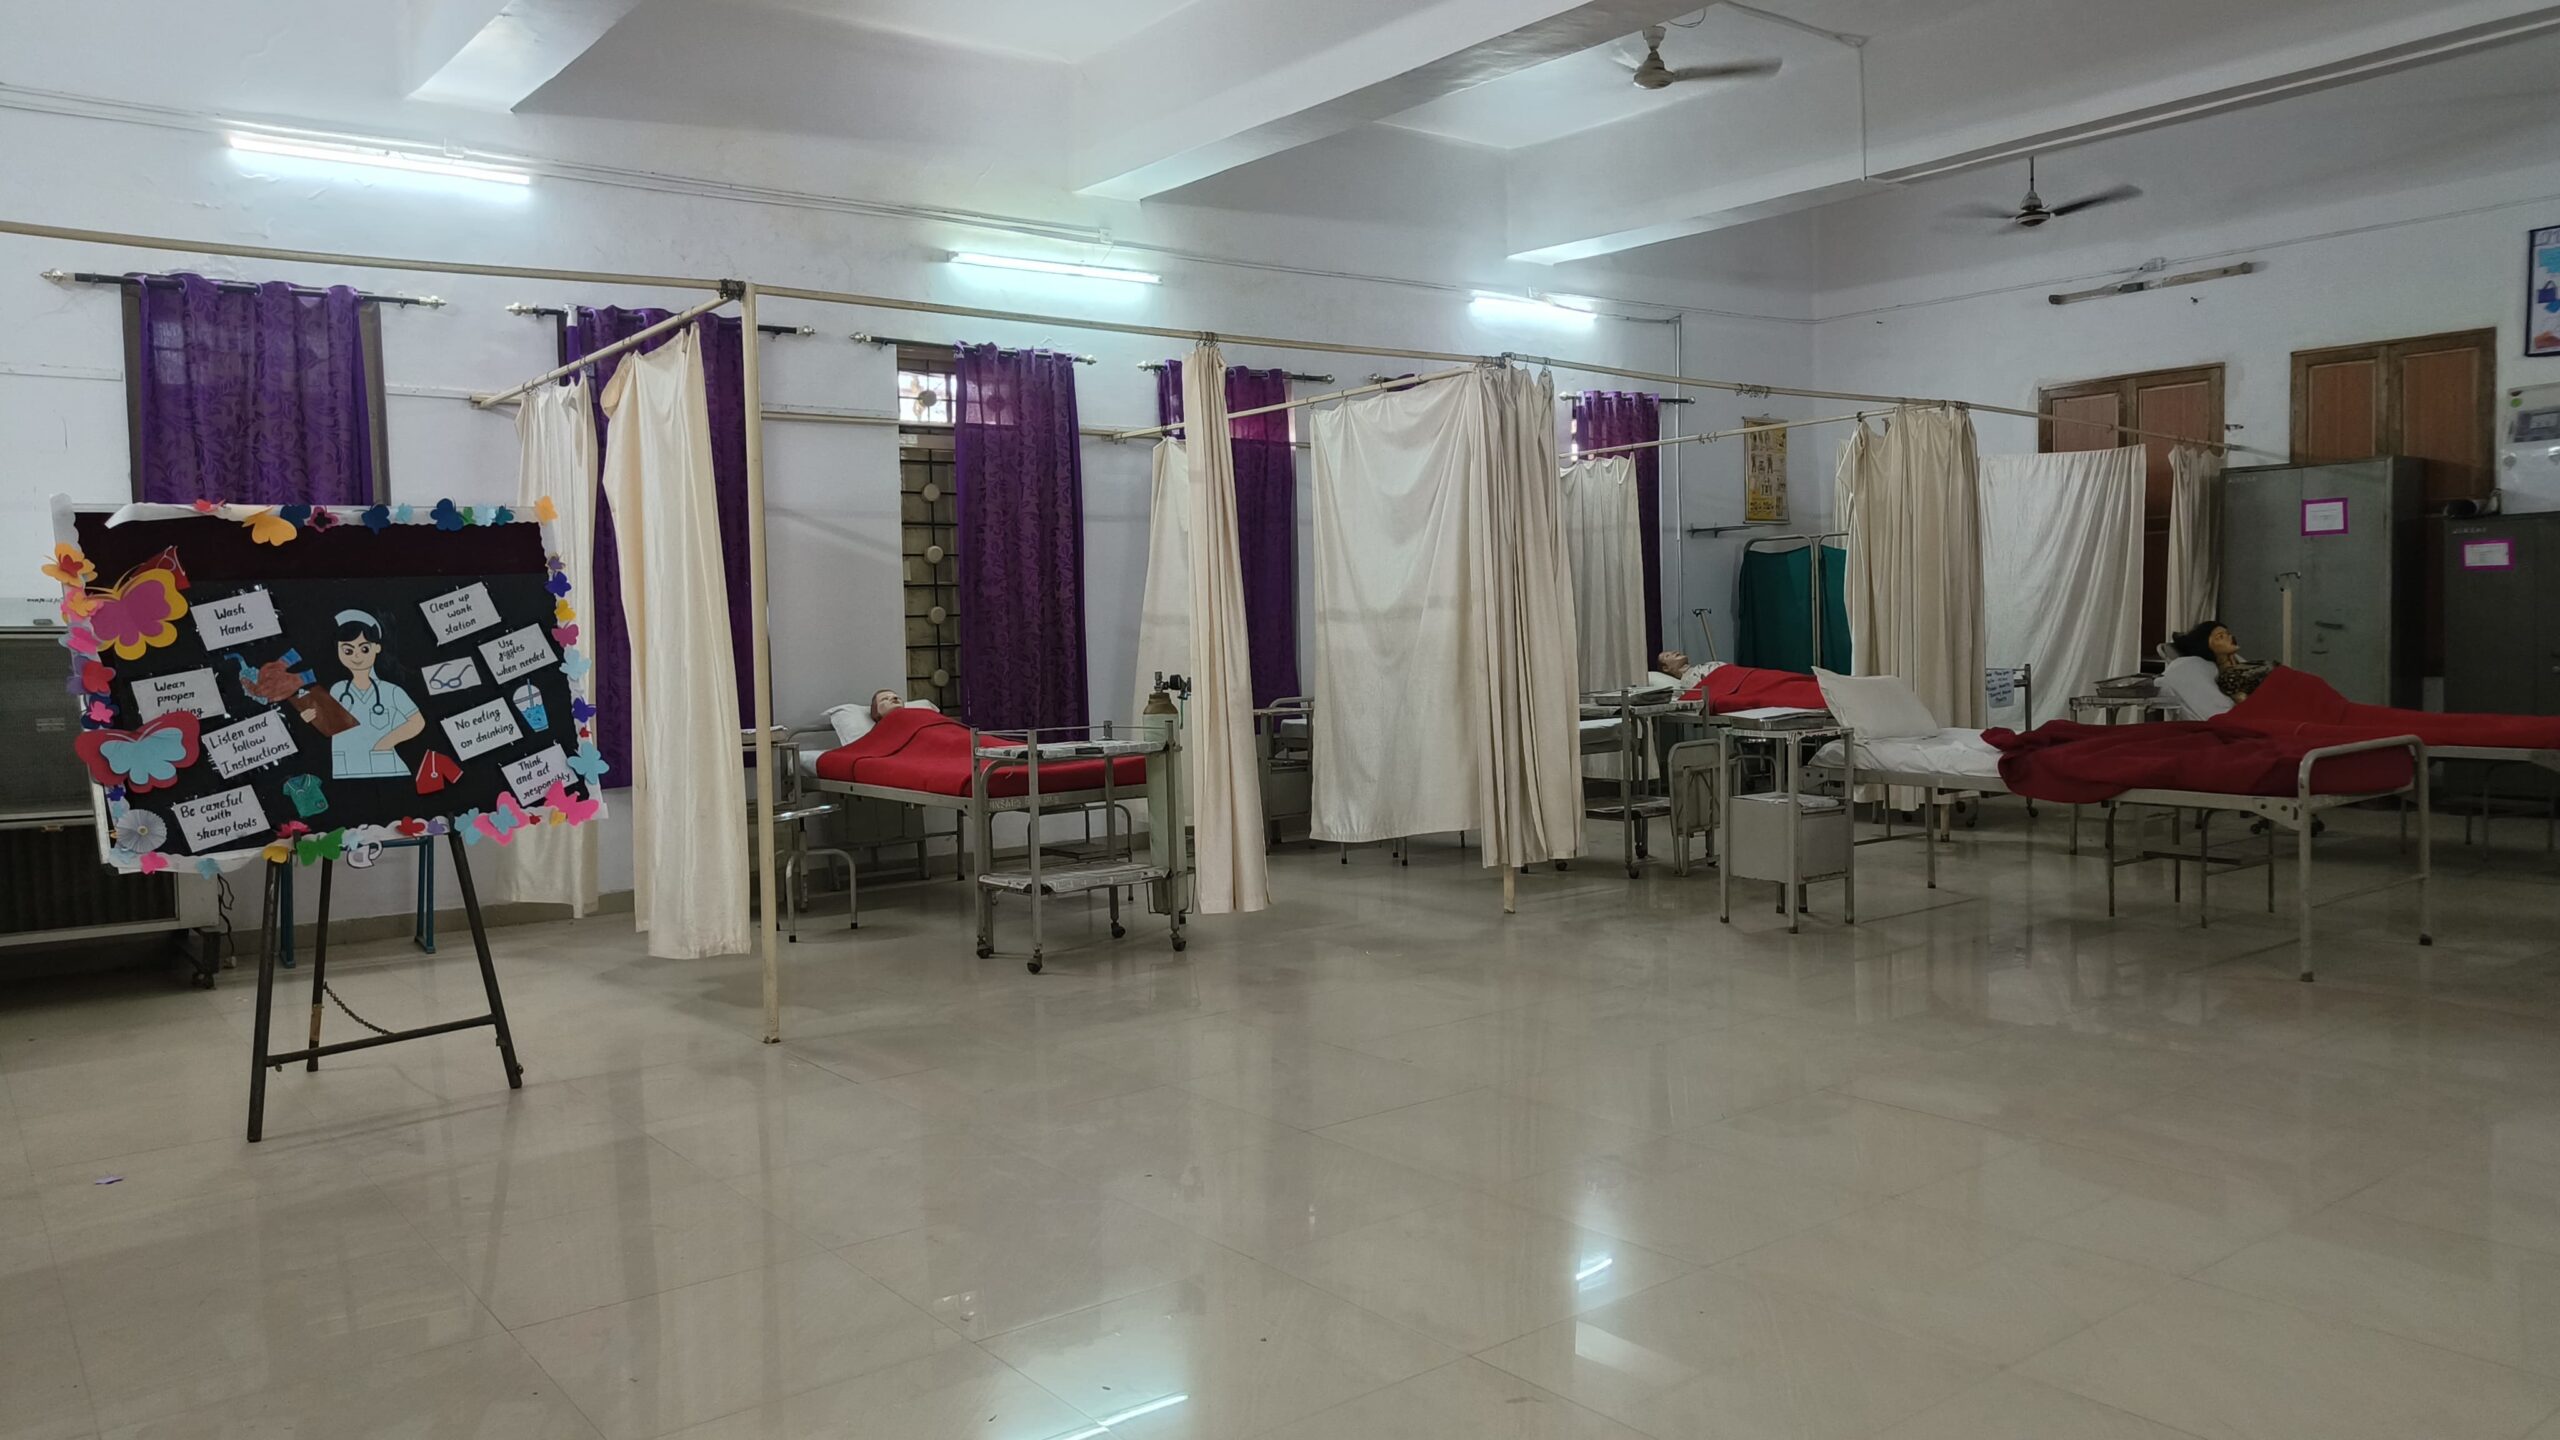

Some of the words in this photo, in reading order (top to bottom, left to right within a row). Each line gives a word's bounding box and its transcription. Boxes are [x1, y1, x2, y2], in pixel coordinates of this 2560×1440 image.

[214, 603, 246, 620] Wash
[430, 600, 454, 614] Clean
[458, 593, 470, 602] up
[447, 603, 473, 618] work
[219, 621, 254, 636] Hands
[445, 618, 477, 636] station
[498, 639, 513, 649] Use
[496, 664, 518, 677] when
[520, 649, 546, 668] needed
[154, 681, 185, 692] Wear
[157, 691, 195, 707] proper
[455, 719, 470, 731] No
[472, 709, 501, 726] eating
[209, 731, 244, 749] Listen
[248, 716, 268, 734] and
[460, 740, 473, 749] or
[476, 723, 514, 743] drinking
[232, 735, 266, 754] follow
[221, 742, 290, 776] Instructions
[518, 755, 543, 771] Think
[516, 771, 533, 785] and
[537, 761, 550, 777] act
[180, 805, 195, 818] Be
[200, 791, 243, 814] careful
[206, 809, 231, 823] with
[196, 825, 231, 840] sharp
[233, 817, 257, 831] tools
